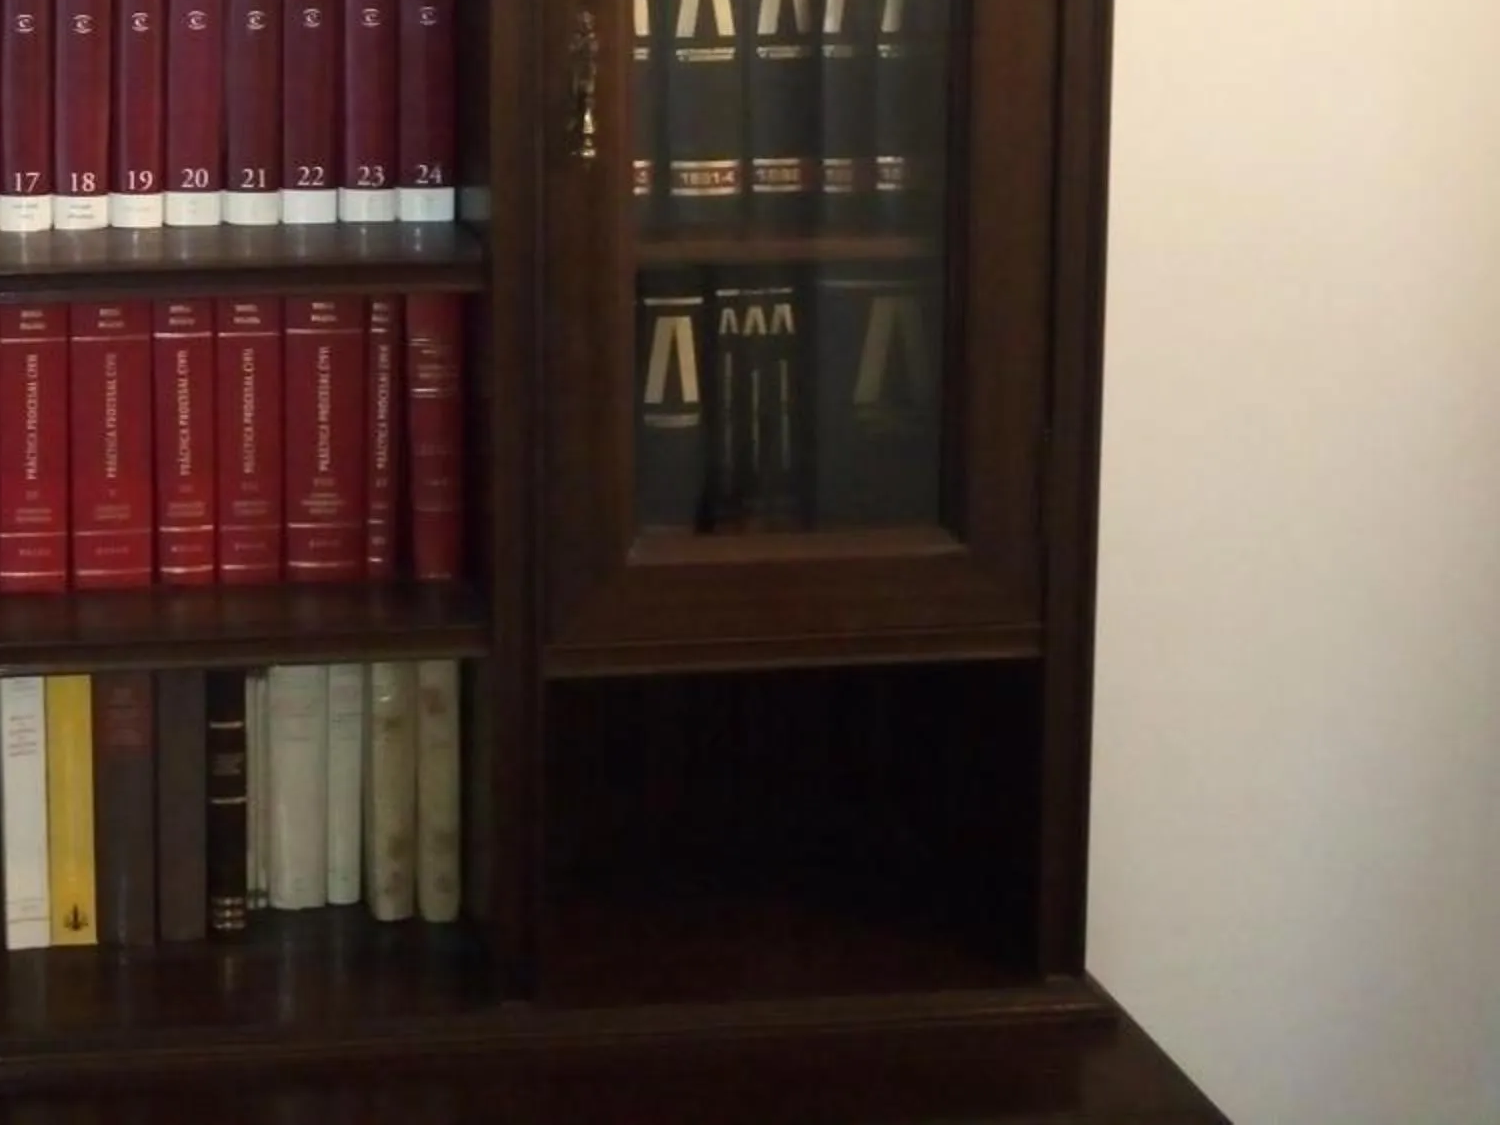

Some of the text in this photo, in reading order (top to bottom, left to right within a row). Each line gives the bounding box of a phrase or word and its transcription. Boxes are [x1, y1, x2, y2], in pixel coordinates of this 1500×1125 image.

[14, 172, 41, 193] 17
[70, 172, 96, 193] 18
[128, 170, 153, 190] 19
[181, 168, 209, 189] 20
[241, 168, 266, 188] 21
[297, 166, 325, 186] 22
[357, 165, 385, 187] 23
[415, 164, 443, 185] 24
